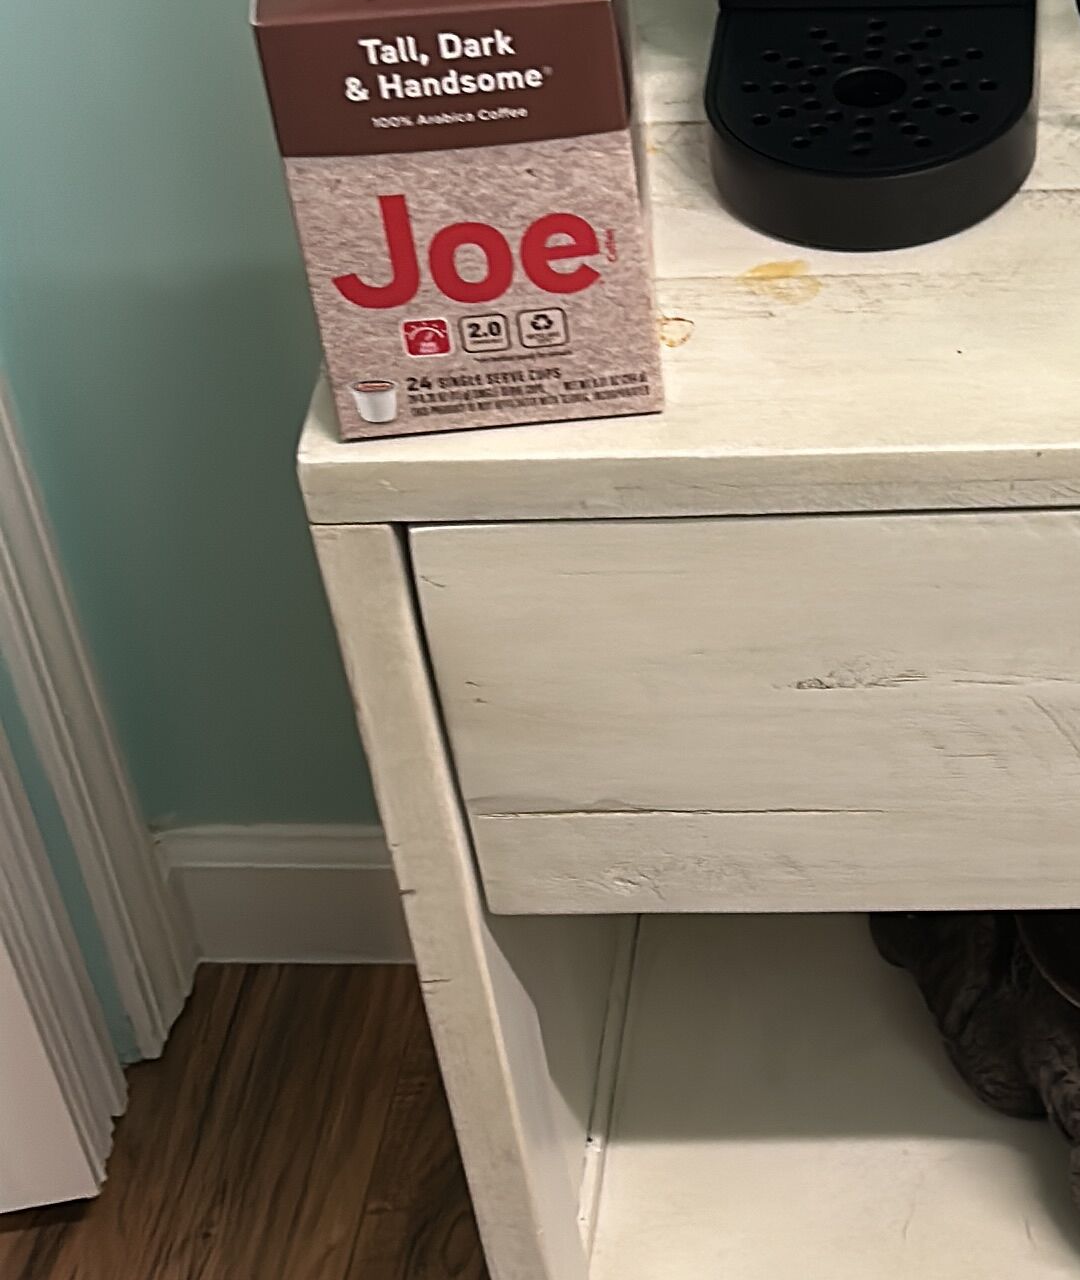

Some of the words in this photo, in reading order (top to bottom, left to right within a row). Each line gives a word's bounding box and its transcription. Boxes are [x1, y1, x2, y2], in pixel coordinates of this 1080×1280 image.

[358, 35, 430, 67] Tall,
[436, 28, 516, 60] Dark
[344, 76, 370, 102] &
[377, 67, 544, 100] Handsome
[477, 107, 529, 121] Coffee
[332, 194, 600, 310] Joe
[468, 321, 502, 339] 2.0
[407, 376, 432, 392] 24
